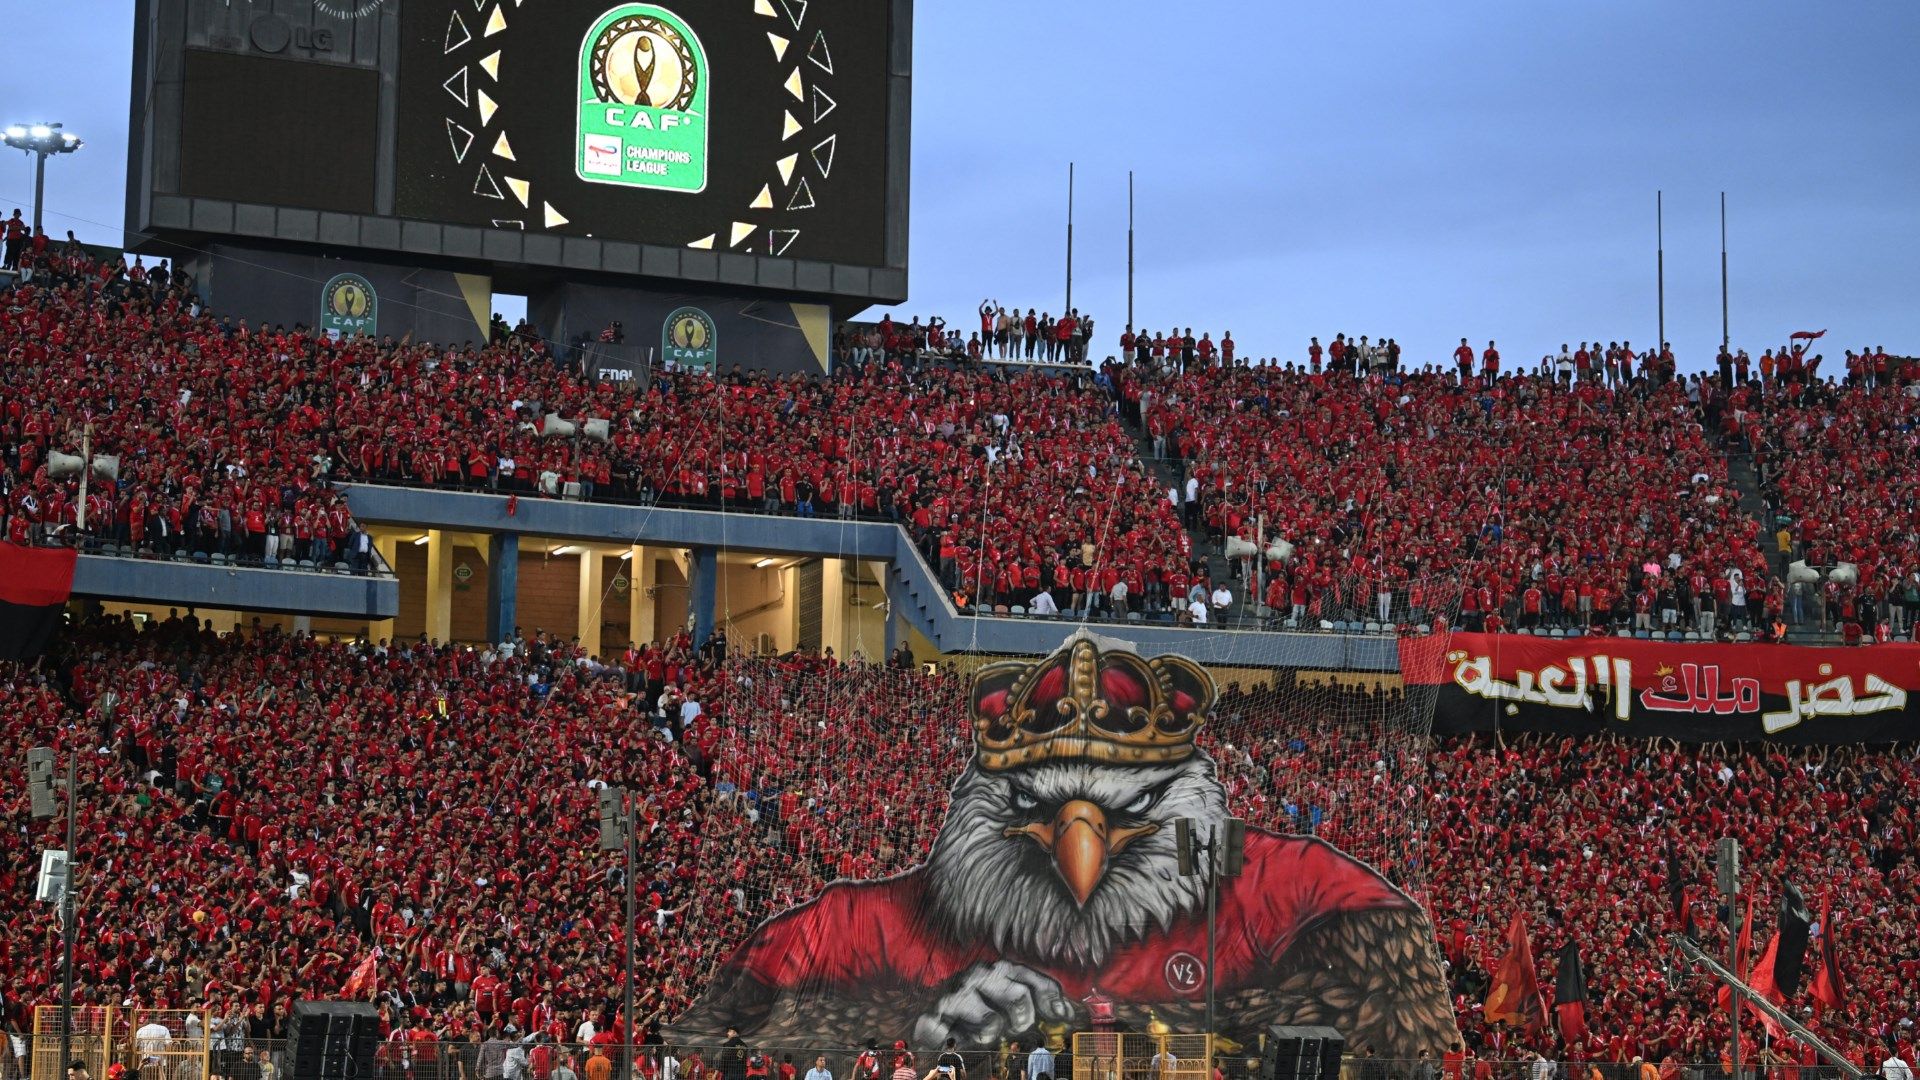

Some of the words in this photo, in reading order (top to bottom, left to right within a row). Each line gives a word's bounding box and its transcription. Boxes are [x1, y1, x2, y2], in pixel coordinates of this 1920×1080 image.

[297, 26, 333, 51] LG
[605, 107, 680, 132] CAF
[626, 145, 691, 164] CHAMPIONS
[626, 160, 669, 176] LEAGUE
[333, 316, 364, 327] CAF
[673, 349, 705, 359] CAF
[1640, 663, 1760, 715] ملك
[1762, 663, 1907, 734] حضر
